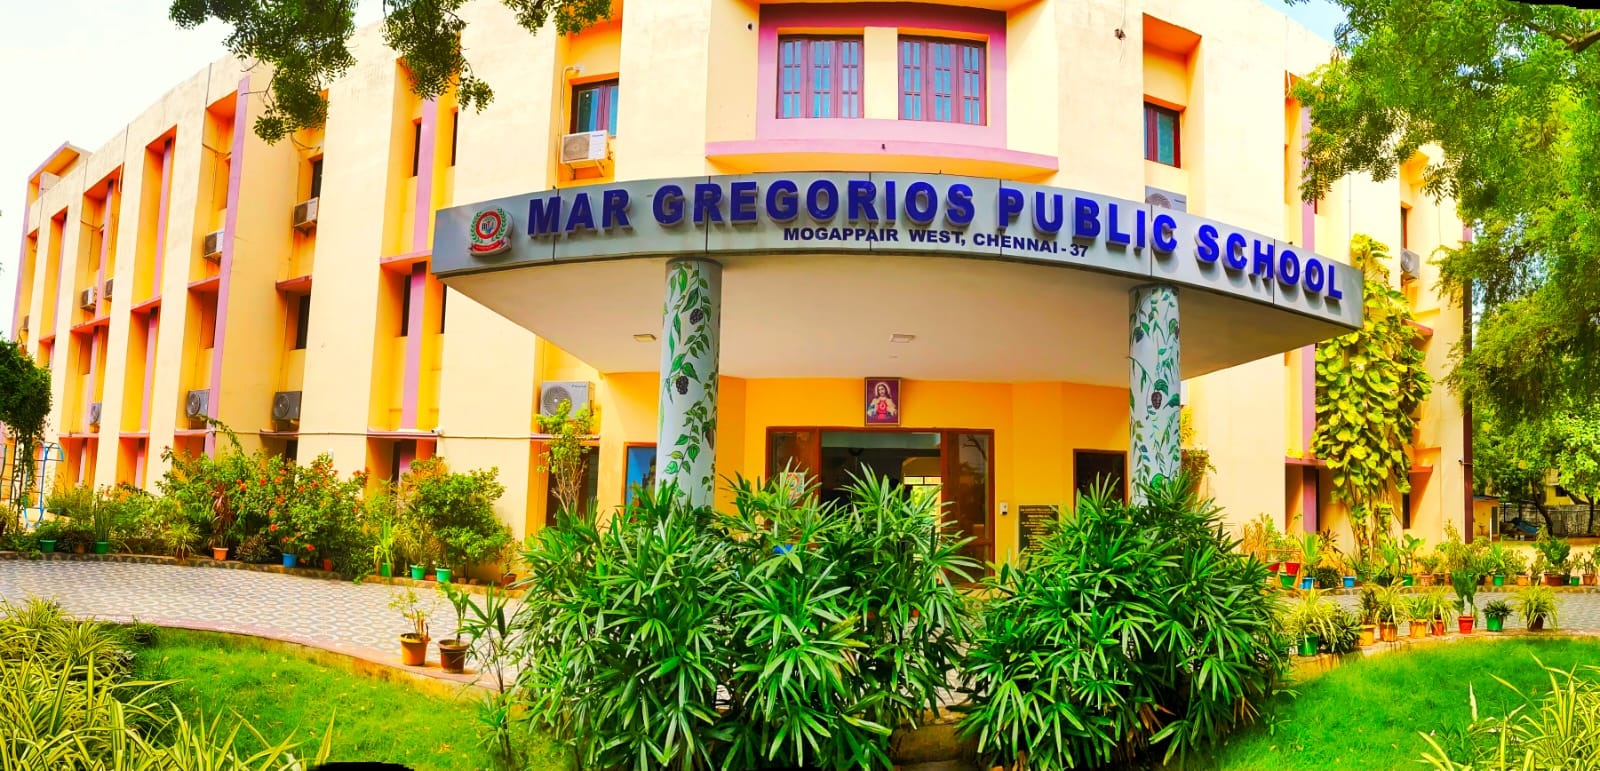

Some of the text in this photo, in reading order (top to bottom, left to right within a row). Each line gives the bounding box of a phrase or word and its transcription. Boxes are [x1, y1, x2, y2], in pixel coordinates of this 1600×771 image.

[527, 179, 1344, 301] MAR GREGORIOS PUBLIC SCHOOL
[783, 227, 899, 242] MOGAPPAIR
[909, 229, 967, 247] WEST,
